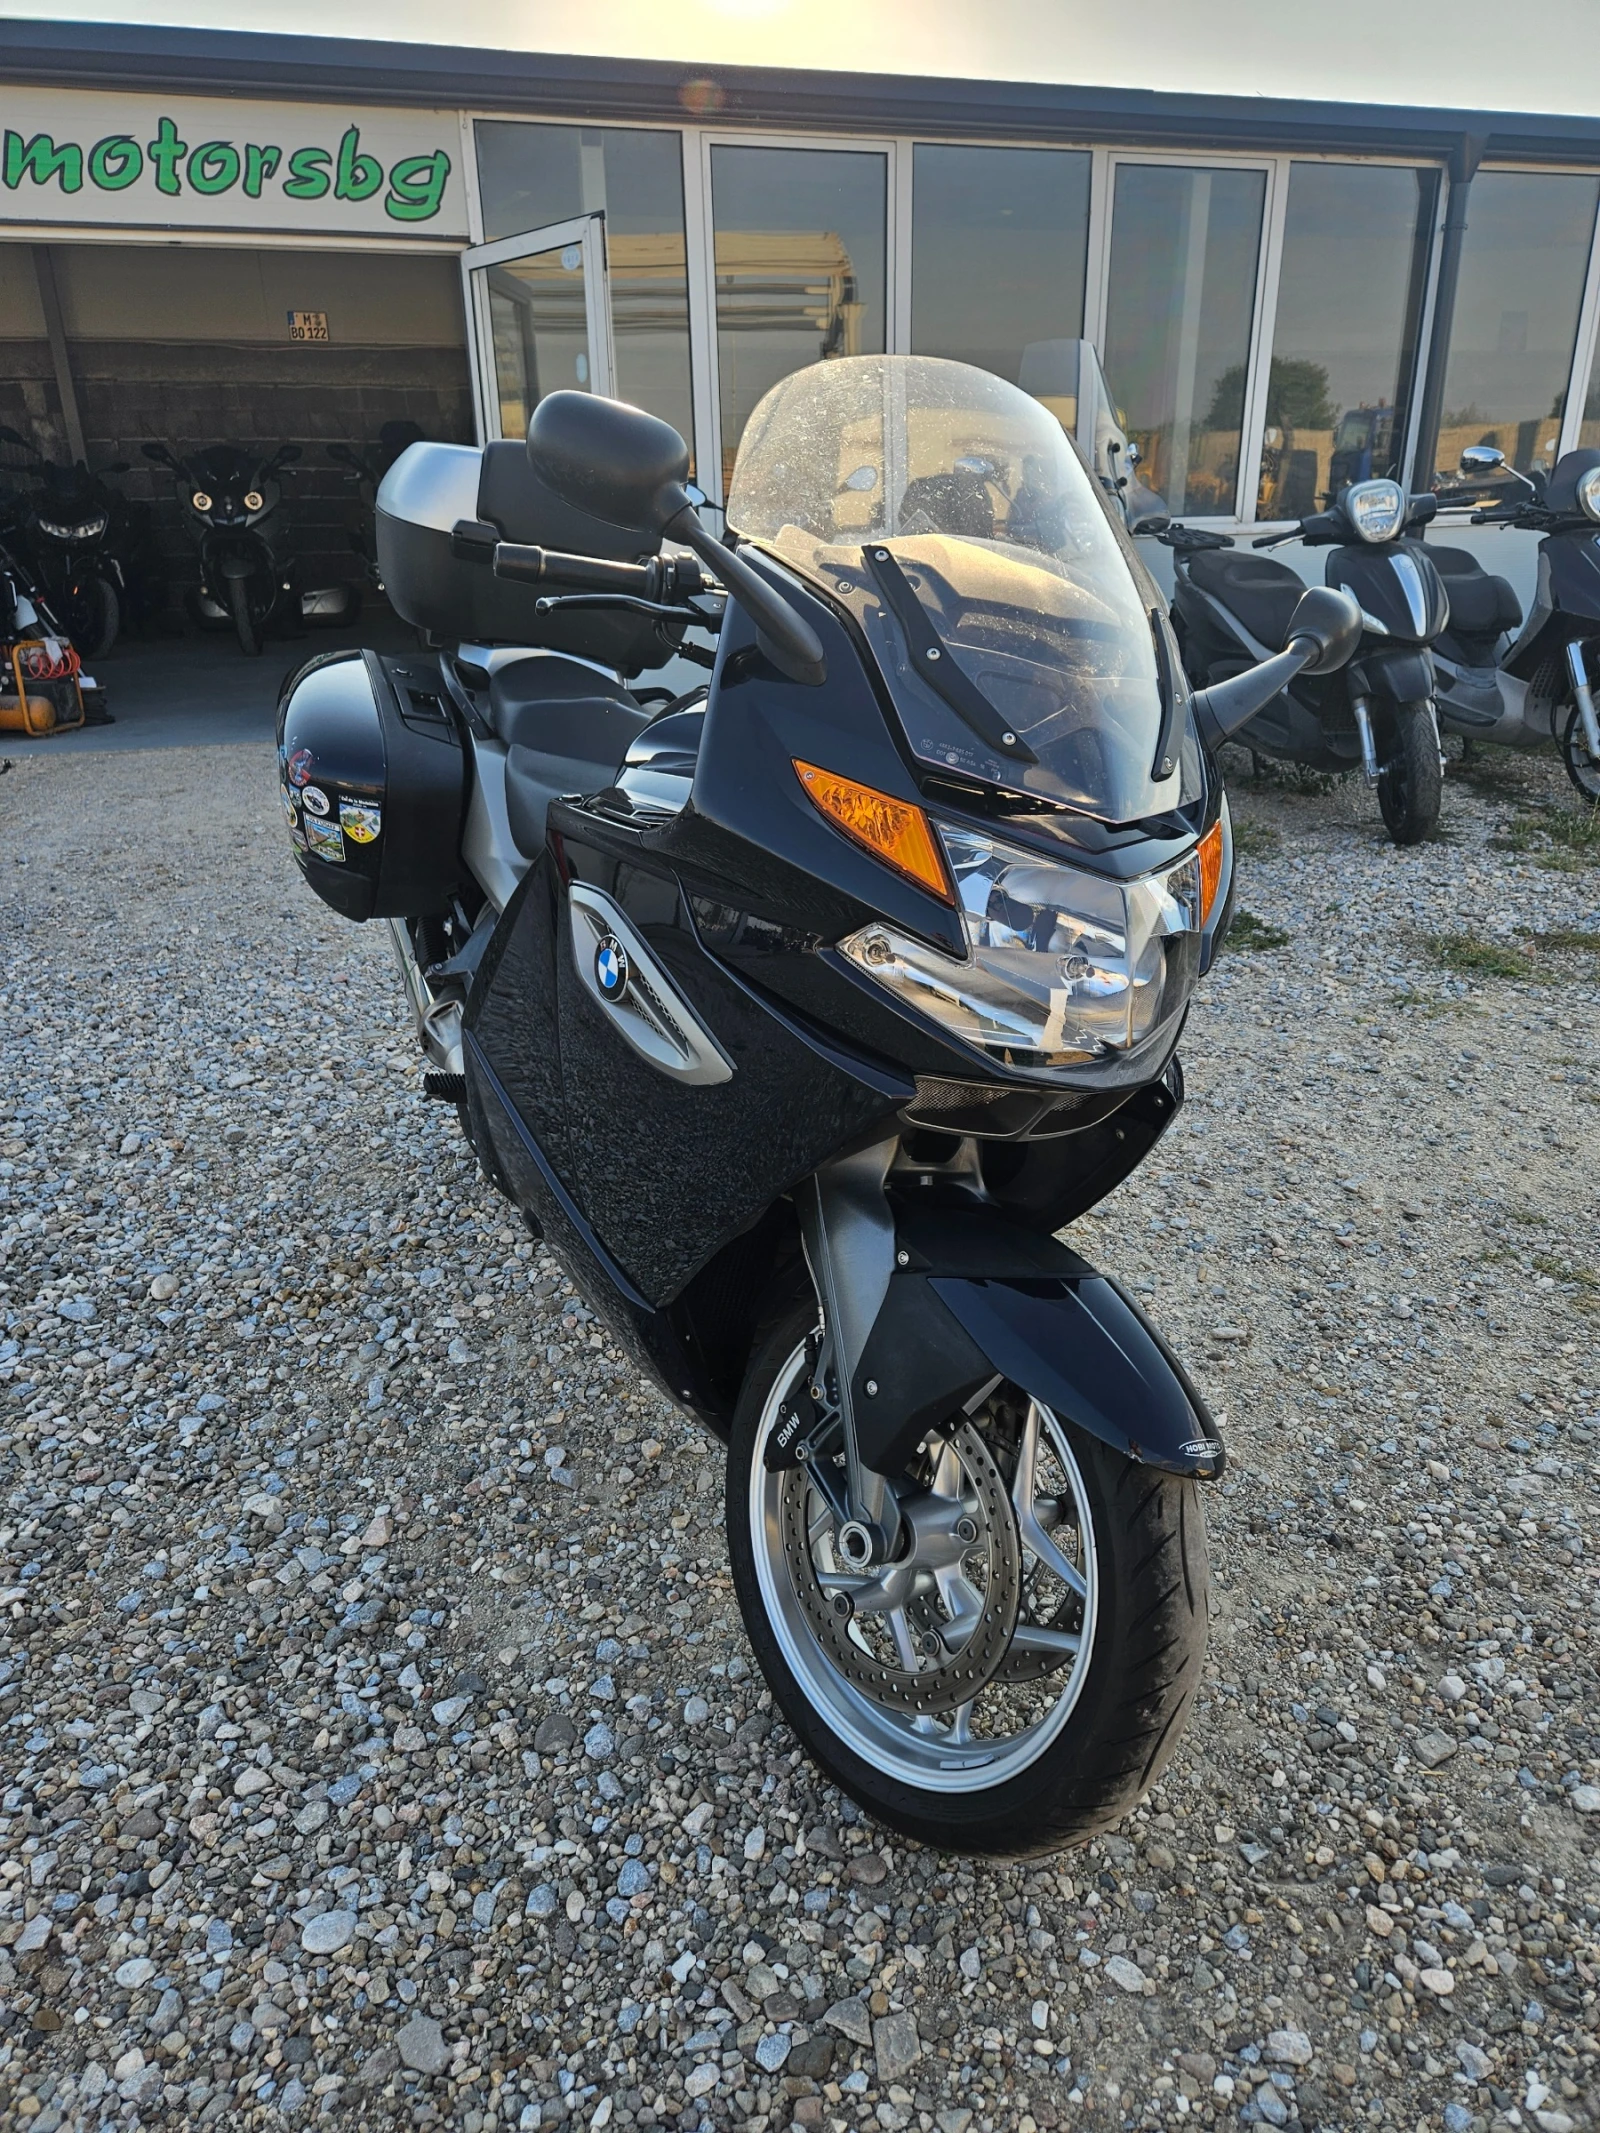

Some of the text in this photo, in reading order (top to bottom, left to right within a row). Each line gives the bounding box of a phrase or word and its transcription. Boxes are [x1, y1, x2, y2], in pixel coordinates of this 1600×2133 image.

[2, 116, 452, 222] motorsbg
[306, 327, 327, 340] 122
[600, 939, 626, 968] BMW
[777, 1412, 800, 1448] BMW
[1185, 1442, 1206, 1453] HOBI
